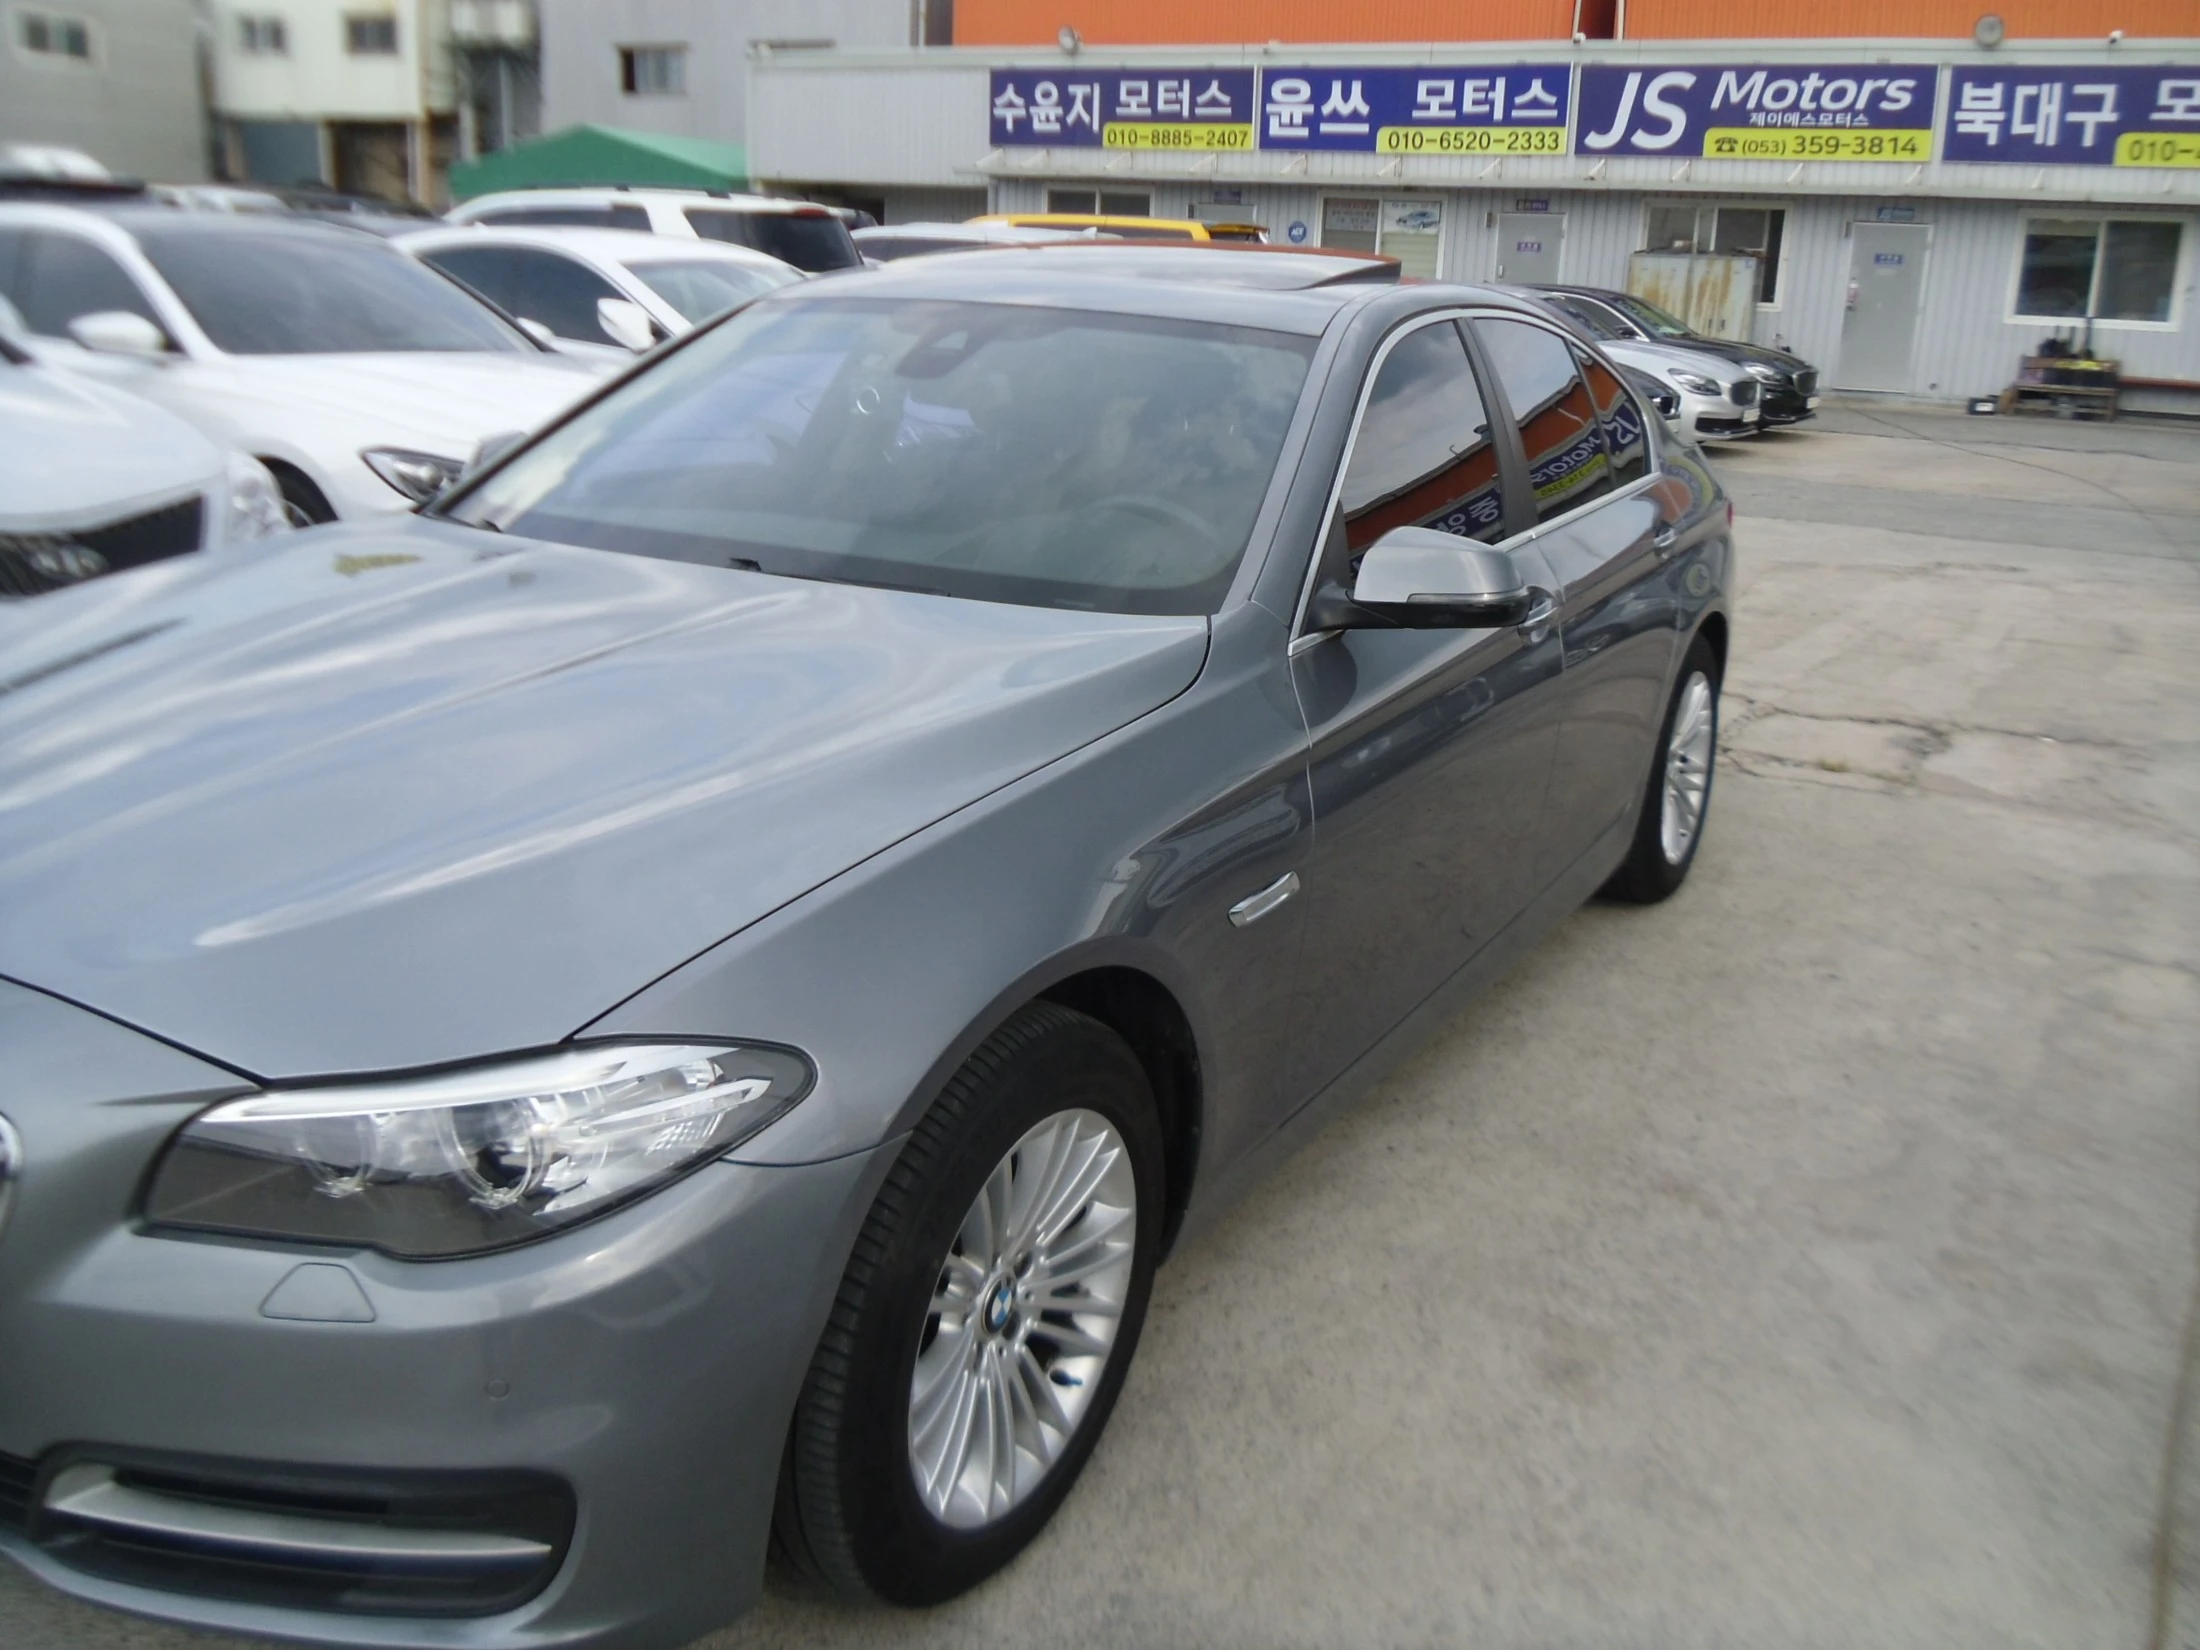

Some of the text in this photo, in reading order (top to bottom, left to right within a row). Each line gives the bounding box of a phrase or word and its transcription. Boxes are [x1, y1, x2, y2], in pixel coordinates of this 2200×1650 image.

[993, 79, 1232, 134] 수윤지 모터스
[1266, 77, 1558, 138] 윤쓰 모터스
[1584, 71, 1917, 149] JS Motors
[1749, 112, 1870, 128] 제이에스모터스
[1954, 81, 2120, 147] 북대구
[1107, 128, 1249, 147] 010-8885-2407
[1388, 131, 1560, 151] 010-6520-2333
[1742, 135, 1918, 155] (053) 359-3814
